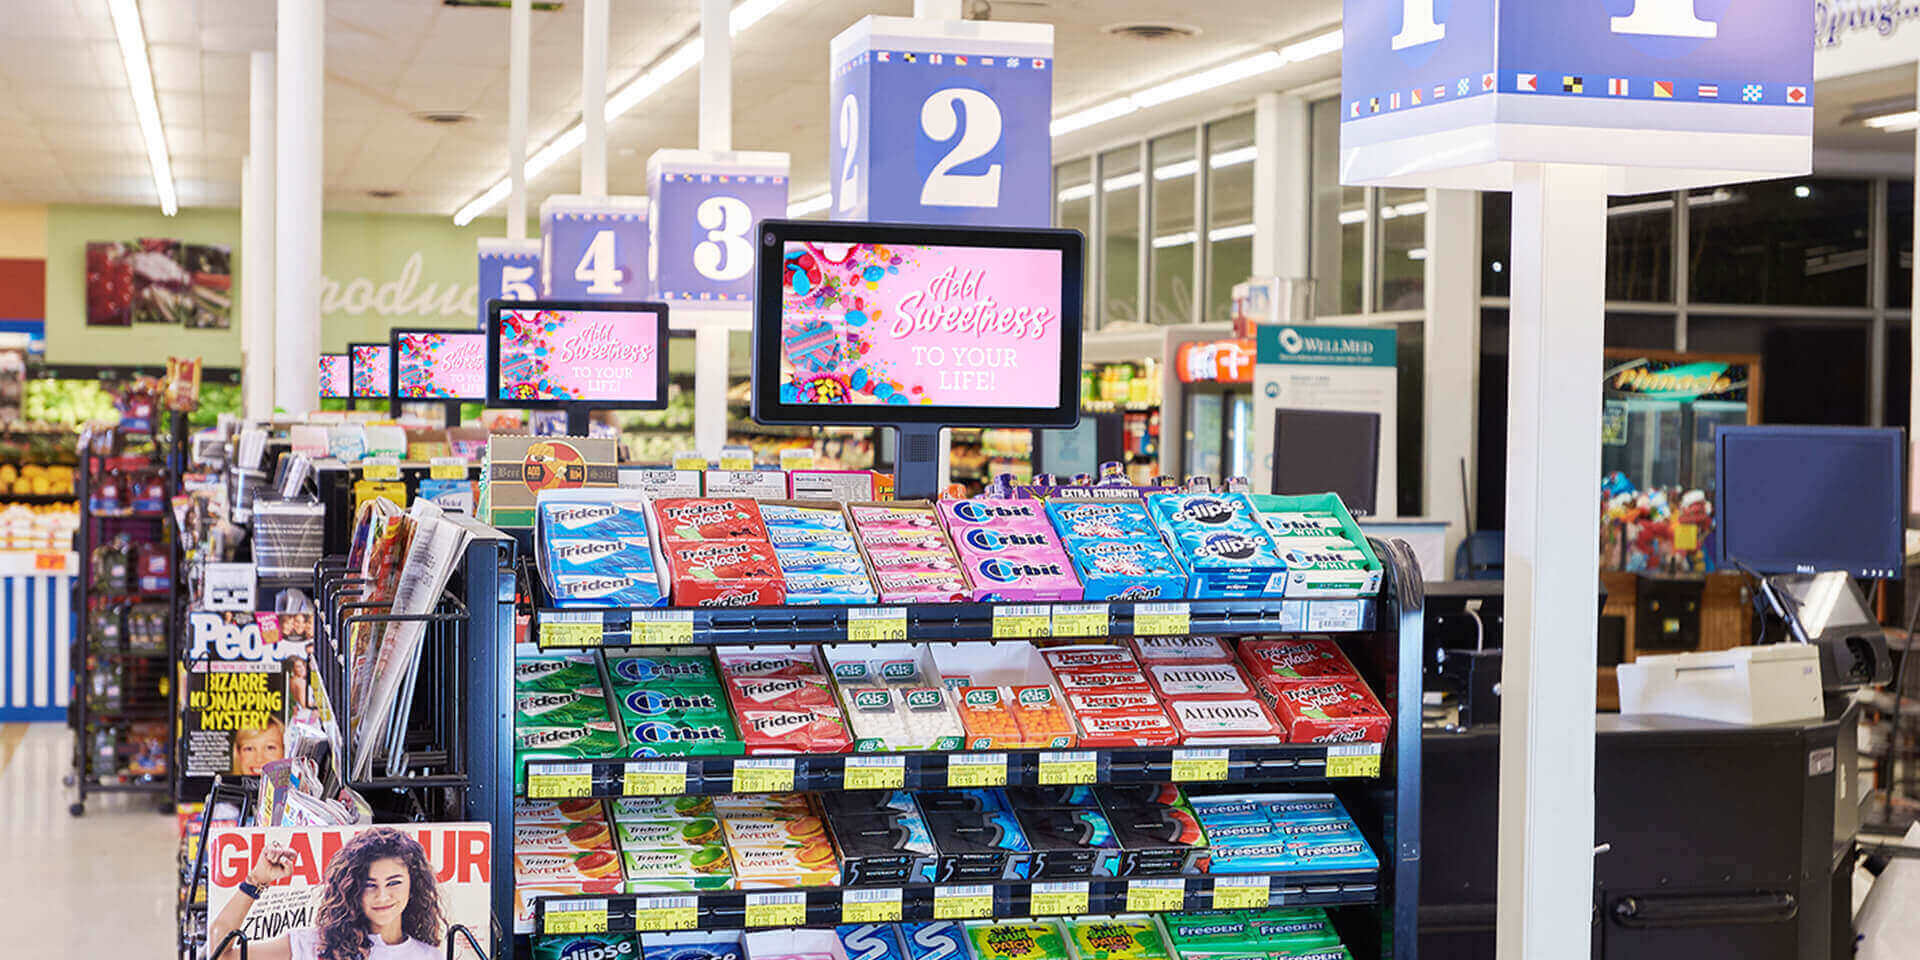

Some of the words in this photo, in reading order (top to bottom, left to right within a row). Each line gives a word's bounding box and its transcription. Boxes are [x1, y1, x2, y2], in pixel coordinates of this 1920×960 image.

[838, 94, 859, 213] 2
[919, 87, 1002, 208] 2
[694, 197, 754, 280] 3
[575, 231, 623, 294] 4
[501, 265, 537, 300] 5
[928, 265, 985, 302] Add
[890, 290, 1054, 340] Sweetness
[560, 335, 655, 363] Sweetness
[911, 346, 945, 366] TO
[951, 347, 1018, 368] YOUR
[572, 367, 595, 379] TO
[597, 367, 633, 379] YOUR
[938, 370, 996, 391] LIFE!
[587, 379, 621, 393] LIFE!
[1061, 488, 1092, 498] EXTRA
[1093, 488, 1140, 499] STRENGTH
[550, 505, 619, 522] Trident
[664, 501, 736, 519] Trident
[952, 501, 1035, 524] Orbit
[1058, 505, 1126, 520] Trident
[1171, 500, 1247, 522] eclipse
[675, 513, 734, 531] Splash
[965, 528, 1049, 552] Orbit
[1193, 535, 1268, 558] eclipse
[553, 541, 626, 558] Trident
[677, 544, 751, 561] Trident
[1079, 542, 1147, 557] Trident
[689, 554, 748, 572] Splash
[978, 558, 1065, 583] Orbit
[559, 578, 633, 594] Trident
[1058, 652, 1123, 664] Dentyne
[1255, 643, 1317, 659] Trident
[728, 658, 795, 675] Trident
[1271, 653, 1319, 670] Splash
[205, 673, 269, 692] BIZARRE
[1070, 673, 1136, 685] Dentyne
[1163, 671, 1236, 683] ALTOIDS
[736, 680, 806, 698] Trident
[1283, 683, 1347, 702] Trident
[190, 691, 282, 713] KIDNAPPING
[625, 690, 717, 716] Orbit
[1081, 696, 1148, 707] Dentyne
[1298, 693, 1349, 712] Splash
[200, 711, 271, 731] MYSTERY
[747, 712, 819, 731] Trident
[1185, 707, 1260, 720] ALTOIDS
[633, 721, 727, 744] Orbit
[1093, 718, 1161, 730] Dentyne
[618, 807, 668, 815] LAYERS
[625, 834, 675, 843] LAYERS
[731, 831, 780, 840] LAYERS
[519, 866, 571, 875] LAYERS
[631, 863, 682, 871] LAYERS
[740, 859, 790, 868] LAYERS
[238, 906, 314, 944] ZENDAYA!
[991, 937, 1034, 951] PATCH
[1091, 936, 1133, 950] PATCH
